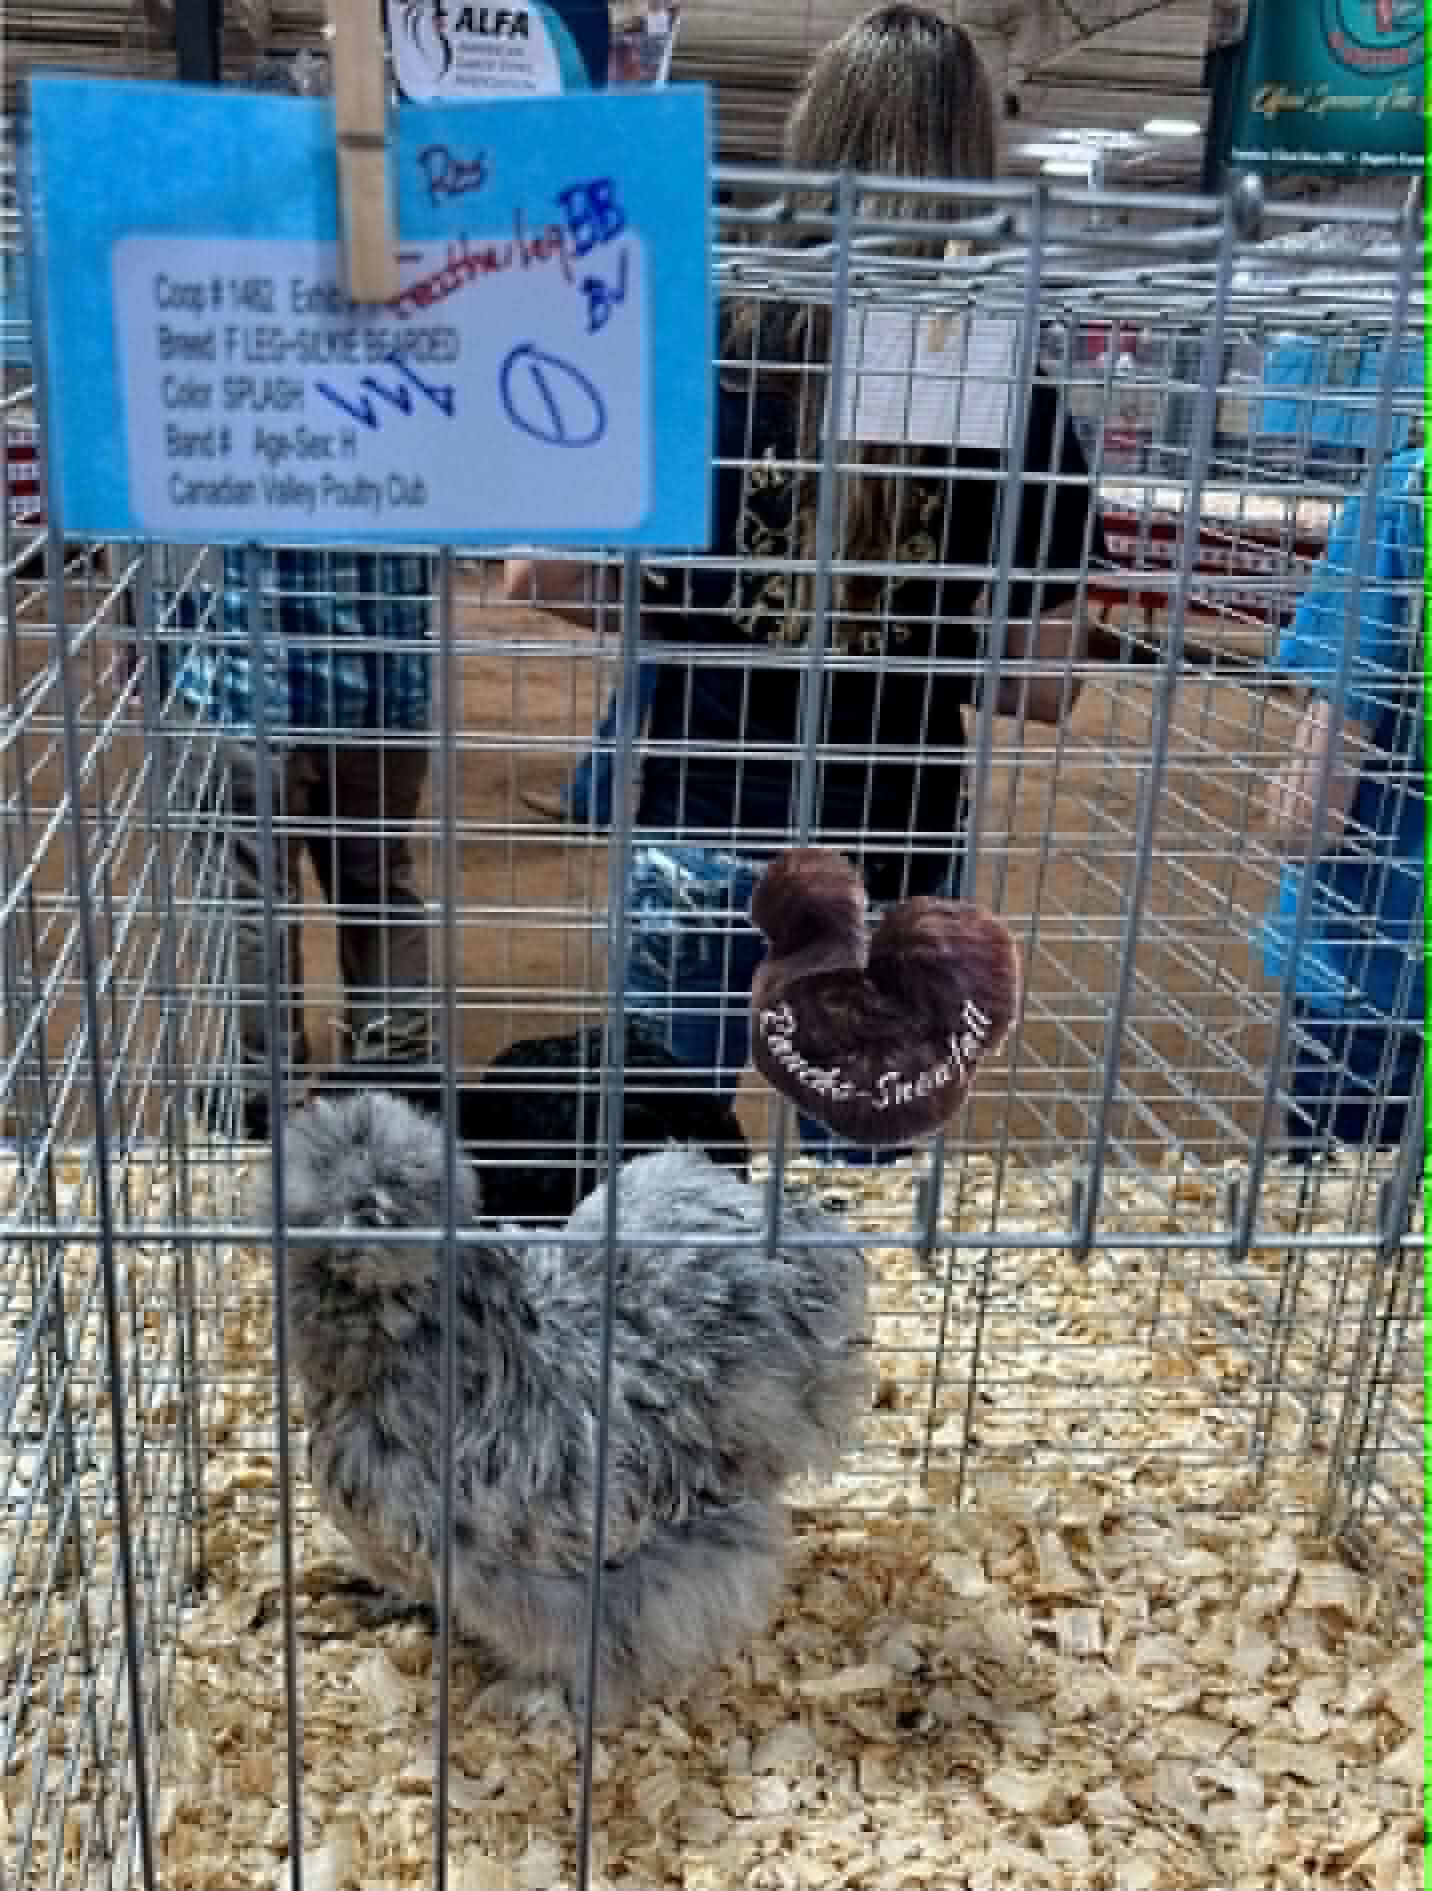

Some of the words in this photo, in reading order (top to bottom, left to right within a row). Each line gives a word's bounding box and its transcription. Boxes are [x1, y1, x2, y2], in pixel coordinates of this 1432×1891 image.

[454, 6, 530, 40] ALFA
[153, 273, 206, 316] Coop
[161, 374, 213, 411] Color
[223, 376, 305, 413] SPLASH
[167, 423, 217, 461] Band
[340, 426, 358, 460] H
[167, 471, 257, 508] Canadian
[260, 473, 318, 517] Valley
[320, 473, 385, 518] Poultry
[386, 473, 428, 507] Club
